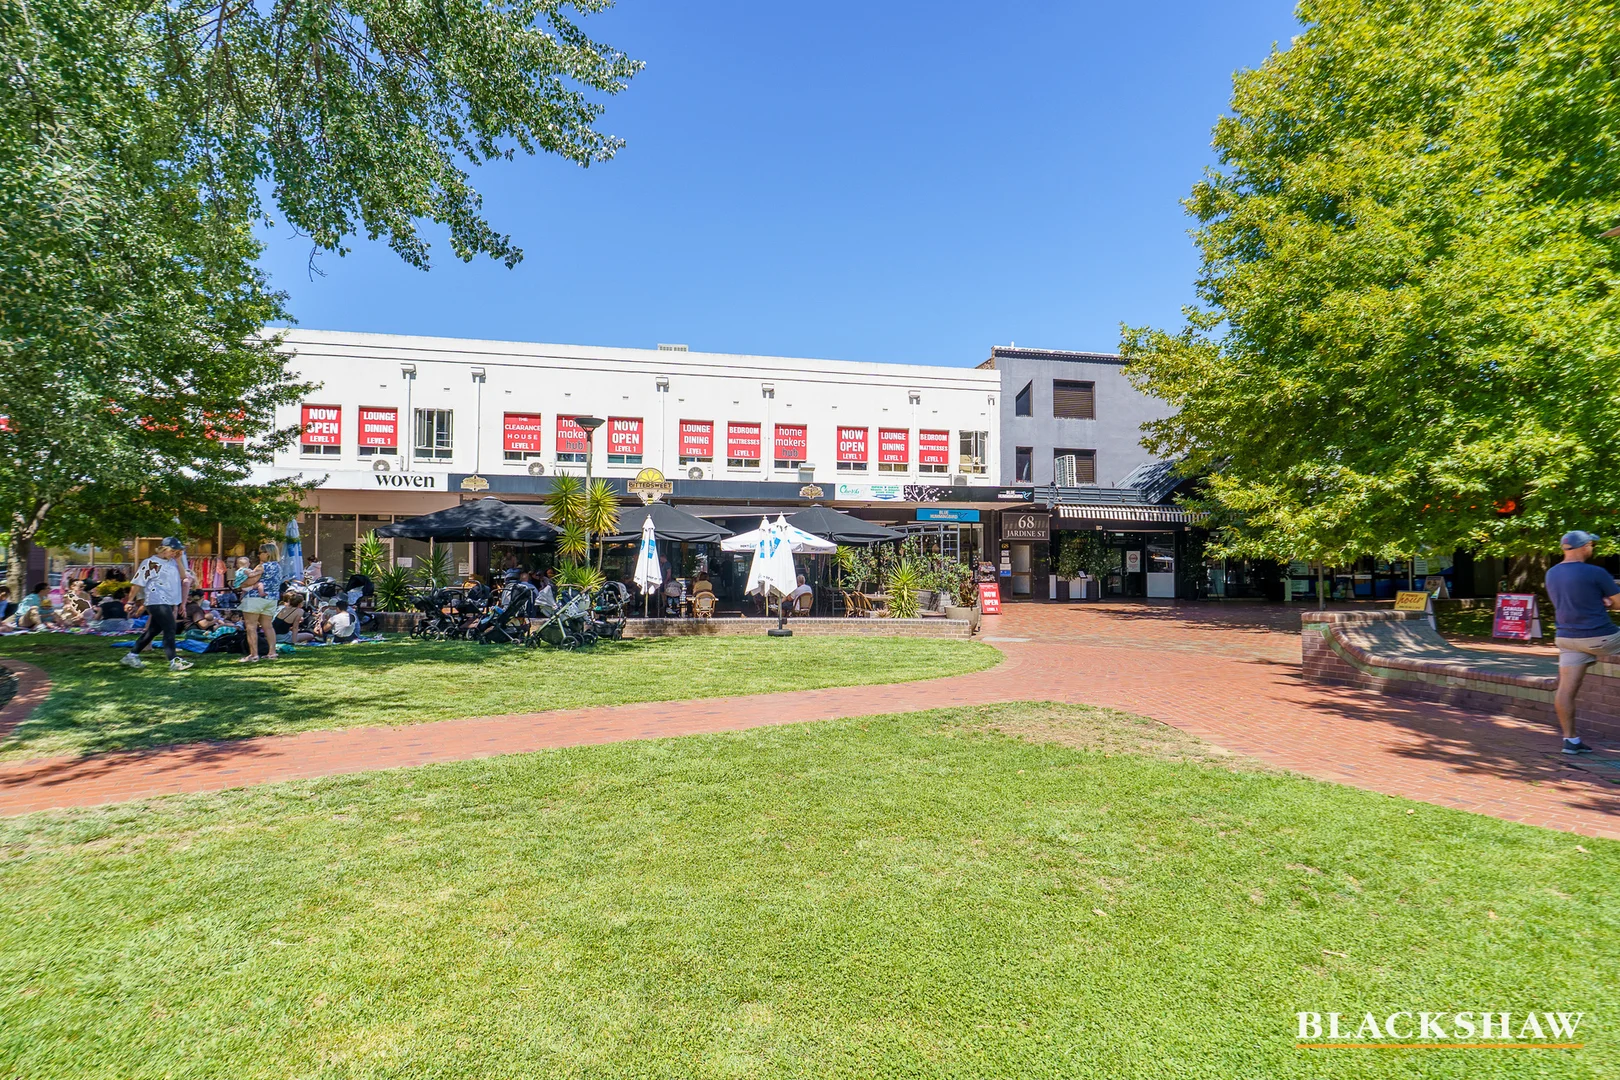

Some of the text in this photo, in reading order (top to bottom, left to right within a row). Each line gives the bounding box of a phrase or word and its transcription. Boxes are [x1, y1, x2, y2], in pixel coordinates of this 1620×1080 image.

[309, 408, 338, 420] NOW
[363, 411, 396, 422] LOUNGE
[306, 422, 338, 434] OPEN
[364, 424, 394, 432] DINING
[614, 420, 638, 432] NOW
[682, 424, 710, 434] LOUNGE
[729, 426, 760, 434] BEDROOM
[779, 426, 802, 436] home
[558, 429, 587, 439] maker
[612, 432, 640, 444] OPEN
[841, 429, 864, 440] NOW
[881, 432, 906, 440] LOUNGE
[919, 433, 948, 442] BEDROOM
[566, 440, 584, 450] hub
[684, 436, 708, 444] DINING
[775, 437, 806, 448] makers
[840, 441, 864, 452] OPEN
[882, 443, 904, 452] DINING
[781, 448, 798, 458] hub
[375, 474, 434, 488] woven
[1017, 514, 1034, 528] 68
[1397, 593, 1424, 604] hour
